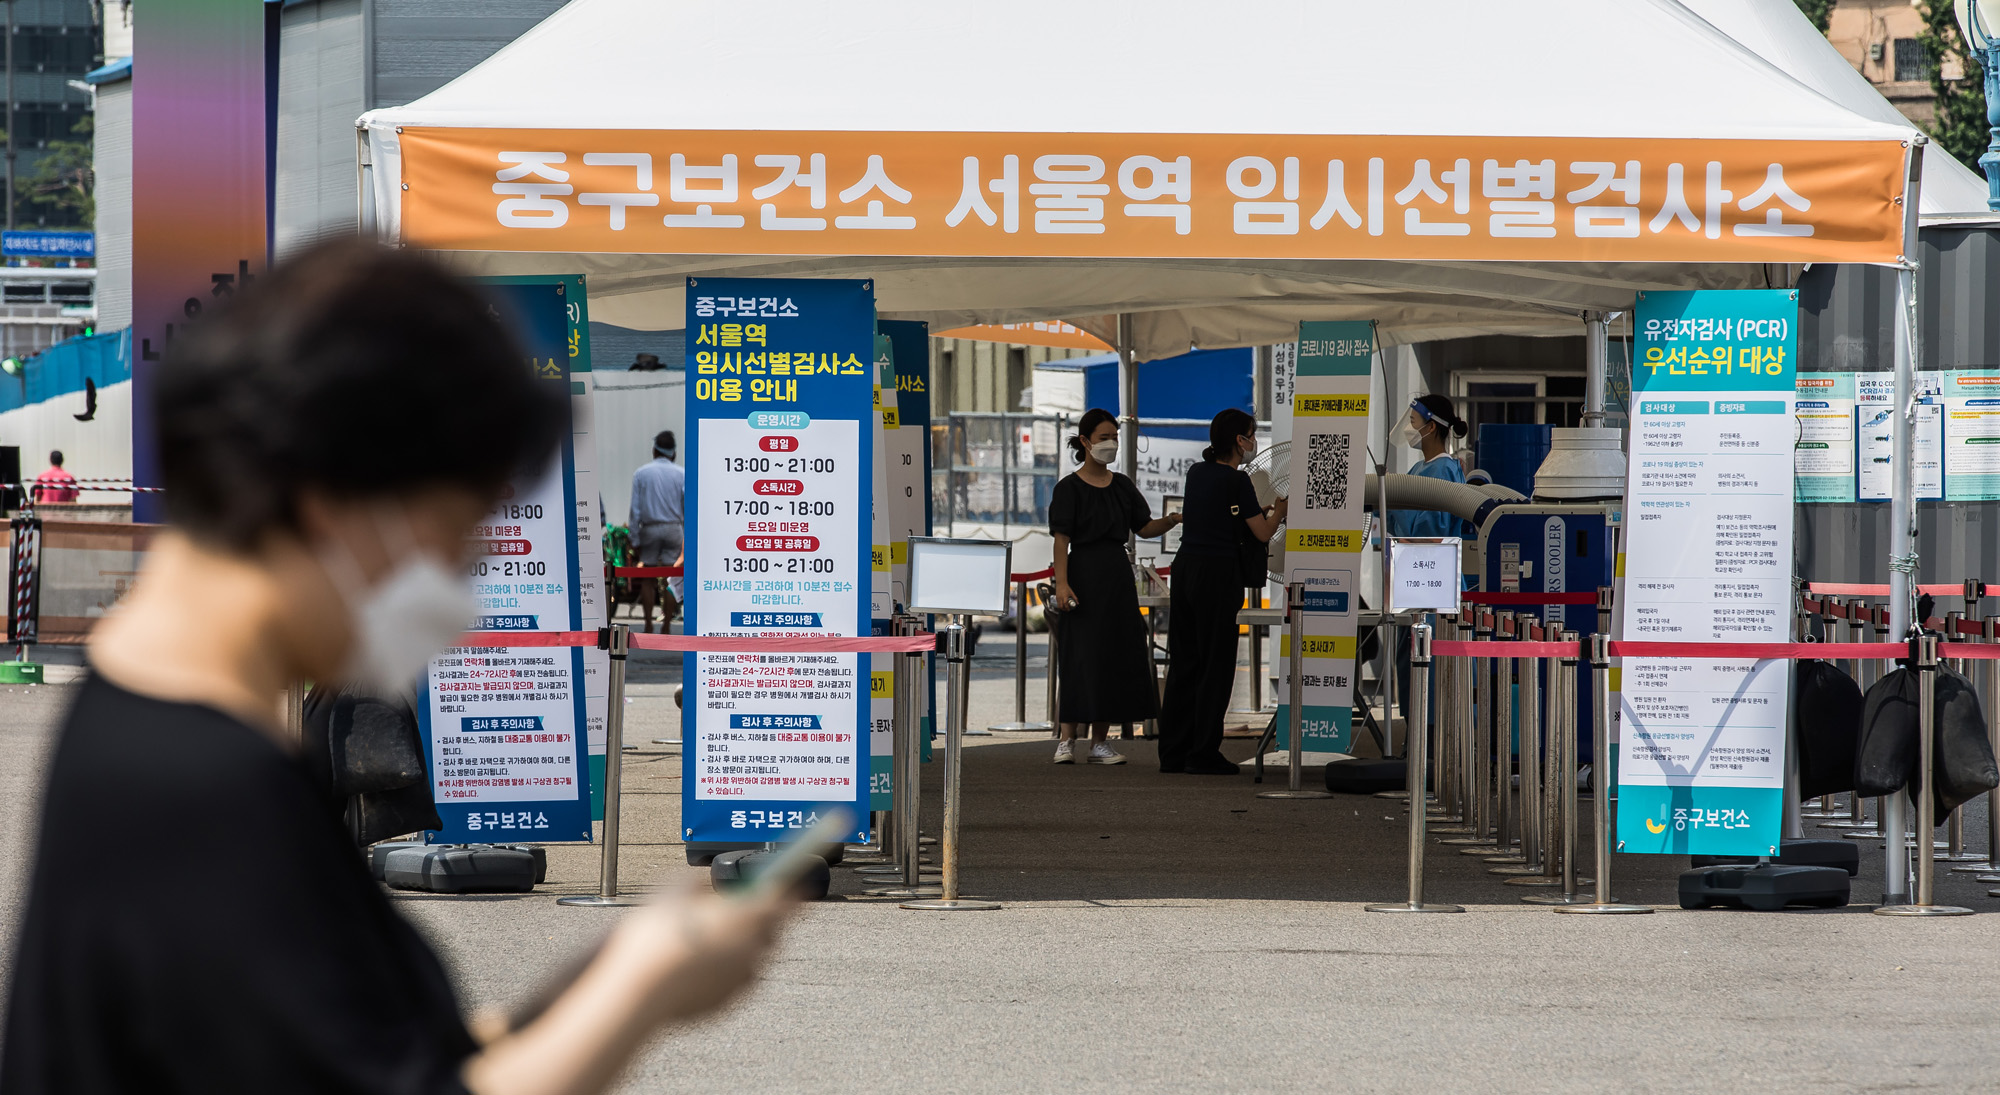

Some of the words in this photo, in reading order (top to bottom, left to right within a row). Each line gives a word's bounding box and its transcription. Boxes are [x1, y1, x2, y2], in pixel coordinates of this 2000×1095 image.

[492, 151, 917, 231] 중구보건소
[945, 154, 1192, 235] 서울역
[1225, 155, 1815, 240] 임시선별검사소
[695, 297, 799, 317] 중구보건소
[696, 323, 766, 347] 서울역
[1644, 318, 1732, 341] 유전자검사
[1737, 318, 1788, 341] (PCR)
[1301, 340, 1335, 357] 코로나19
[1337, 340, 1352, 357] 검사
[1354, 340, 1370, 357] 접수
[696, 351, 864, 376] 임시선별검사소
[1643, 346, 1732, 376] 우선순위
[1739, 346, 1786, 376] 대상
[696, 378, 743, 402] 이용
[750, 378, 797, 402] 안내
[1298, 400, 1303, 411] 1.
[1304, 400, 1320, 411] 휴대폰
[1322, 400, 1342, 411] 카메라를
[1344, 400, 1354, 411] 켜서
[1356, 400, 1366, 411] 스캔
[1719, 404, 1745, 412] 증빙자료
[758, 414, 800, 426] 운영시간
[770, 439, 789, 450] 평일
[725, 458, 770, 473] 13:00
[788, 458, 834, 473] 21:00
[760, 483, 796, 493] 소독시간
[502, 505, 543, 519] 18:00
[725, 501, 769, 516] 17:00
[790, 501, 834, 516] 18:00
[495, 526, 521, 536] 미운영
[748, 522, 777, 532] 토요일
[780, 522, 809, 532] 미운영
[746, 538, 771, 549] 일요일
[774, 538, 782, 549] 및
[785, 538, 811, 549] 공휴일
[1299, 536, 1305, 546] 2.
[1307, 535, 1336, 547] 전자문진표
[1337, 535, 1349, 547] 작성
[500, 543, 524, 552] 공휴일
[1548, 524, 1561, 575] COOLER
[504, 561, 545, 576] 21:00
[724, 558, 768, 573] 13:00
[788, 558, 834, 573] 21:00
[1413, 560, 1436, 569] 소독시간
[476, 584, 511, 594] 고려하여
[514, 584, 543, 594] 10분전
[546, 584, 563, 594] 접수
[704, 580, 752, 591] 검사시간을
[755, 580, 793, 591] 고려하여
[797, 580, 830, 591] 10분전
[834, 580, 852, 591] 접수
[1406, 580, 1420, 588] 17:00
[1427, 580, 1442, 588] 18:00
[752, 594, 803, 605] 마감합니다.
[486, 618, 494, 628] 전
[496, 618, 530, 628] 주의사항
[742, 615, 761, 625] 검사
[763, 615, 772, 625] 전
[775, 615, 813, 625] 주의사항
[1302, 641, 1308, 653] 3.
[1310, 641, 1335, 653] 검사대기
[708, 655, 735, 663] 문진표에
[737, 655, 766, 663] 연락처를
[768, 655, 795, 663] 올바르게
[797, 655, 839, 663] 기재해주세요.
[708, 667, 741, 676] 검사결과는
[743, 667, 785, 676] 24~72시간
[787, 667, 801, 676] 후에
[803, 667, 816, 676] 문자
[818, 667, 853, 676] 전송됩니다.
[708, 679, 754, 688] 검사결과지는
[757, 679, 788, 688] 발급되지
[790, 679, 814, 688] 않으며,
[817, 679, 851, 688] 검사결과지
[1323, 676, 1334, 687] 문자
[1336, 676, 1347, 687] 통보
[708, 691, 729, 700] 발급이
[731, 691, 751, 700] 필요한
[754, 691, 767, 700] 경우
[770, 691, 797, 700] 병원에서
[800, 691, 828, 700] 개별검사
[830, 691, 851, 700] 하시기
[440, 705, 466, 713] 바랍니다.
[472, 719, 488, 730] 검사
[491, 719, 499, 730] 후
[501, 719, 534, 730] 주의사항
[742, 717, 760, 727] 검사
[763, 717, 772, 727] 후
[774, 717, 812, 727] 주의사항
[708, 733, 721, 742] 검사
[723, 733, 729, 742] 후
[731, 733, 746, 742] 버스,
[748, 733, 768, 742] 지하철
[769, 733, 776, 742] 등
[778, 733, 808, 742] 대중교통
[810, 733, 833, 742] 이용이
[836, 733, 851, 742] 불가
[442, 747, 463, 755] 합니다.
[708, 744, 730, 752] 합니다.
[708, 756, 722, 764] 검사
[724, 756, 730, 764] 후
[732, 756, 746, 764] 바로
[749, 756, 776, 764] 자택으로
[779, 756, 814, 764] 귀가하여야
[817, 756, 833, 764] 하며,
[836, 756, 850, 764] 다른
[707, 766, 721, 774] 장소
[722, 766, 743, 774] 방문이
[745, 766, 780, 774] 금지됩니다.
[716, 778, 729, 786] 사항
[731, 778, 758, 786] 위반하여
[760, 778, 780, 786] 감염병
[782, 778, 796, 786] 발생
[798, 778, 804, 786] 시
[806, 778, 827, 786] 구상권
[829, 778, 850, 786] 청구될
[444, 790, 451, 798] 수
[452, 790, 479, 798] 있습니다.
[707, 787, 713, 795] 수
[716, 787, 745, 795] 있습니다.
[467, 812, 549, 831] 중구보건소
[731, 811, 821, 829] 중구보건소
[1673, 808, 1750, 831] 중구보건소
